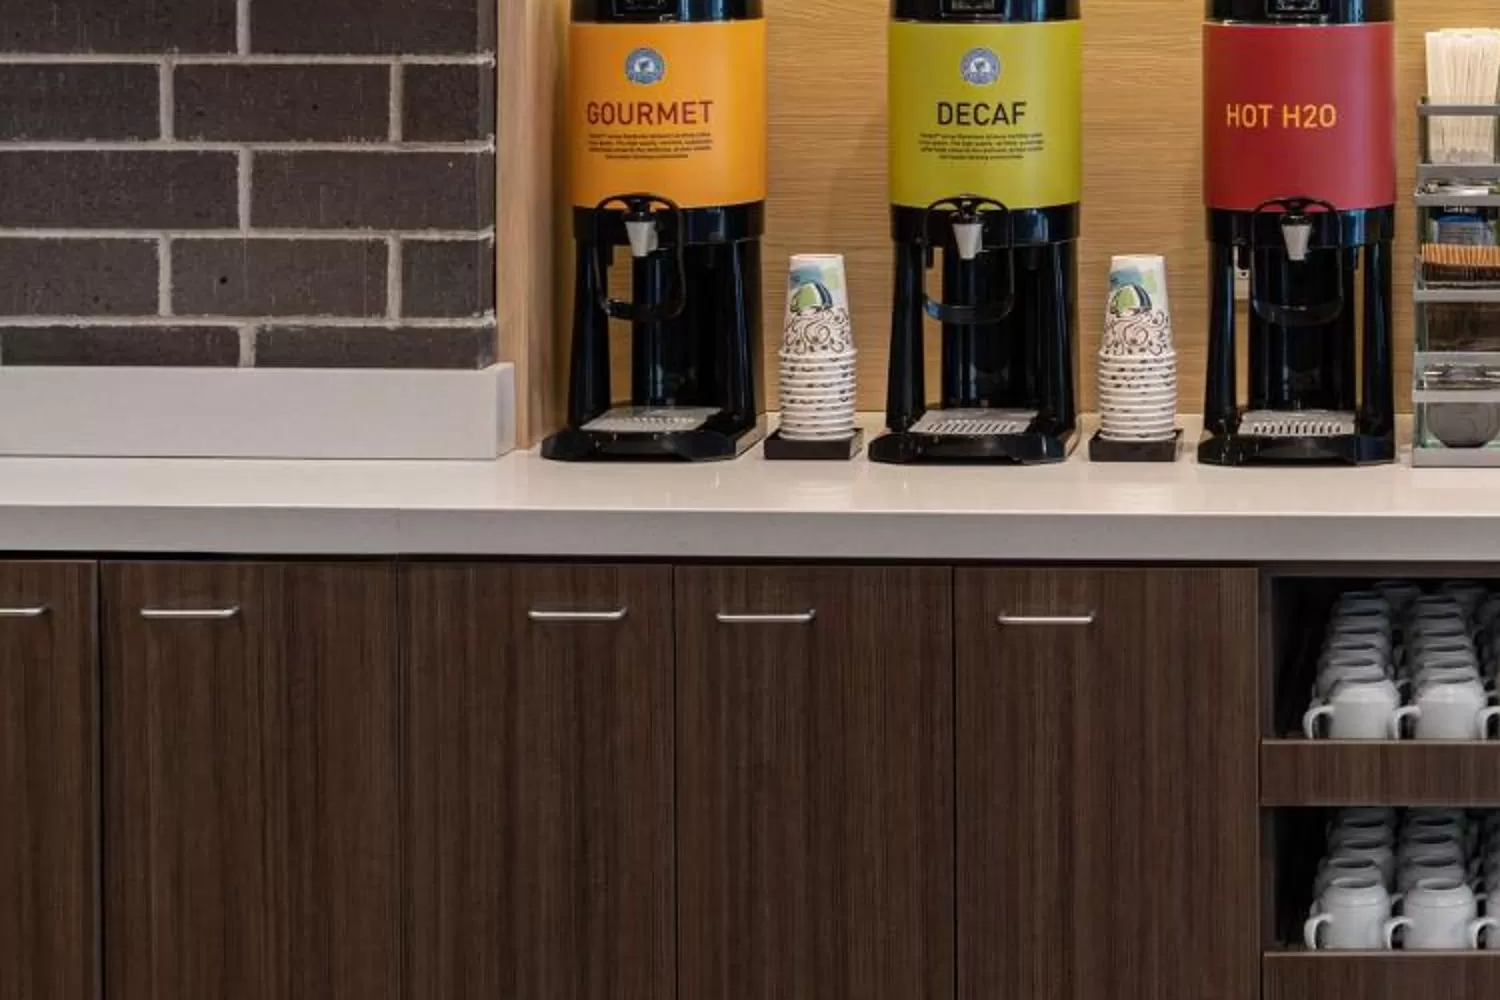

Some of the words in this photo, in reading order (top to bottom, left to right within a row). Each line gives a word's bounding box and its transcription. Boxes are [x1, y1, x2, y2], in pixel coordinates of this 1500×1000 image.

[587, 101, 714, 125] GOURMET
[936, 101, 1027, 126] DECAF
[1226, 103, 1273, 128] HOT
